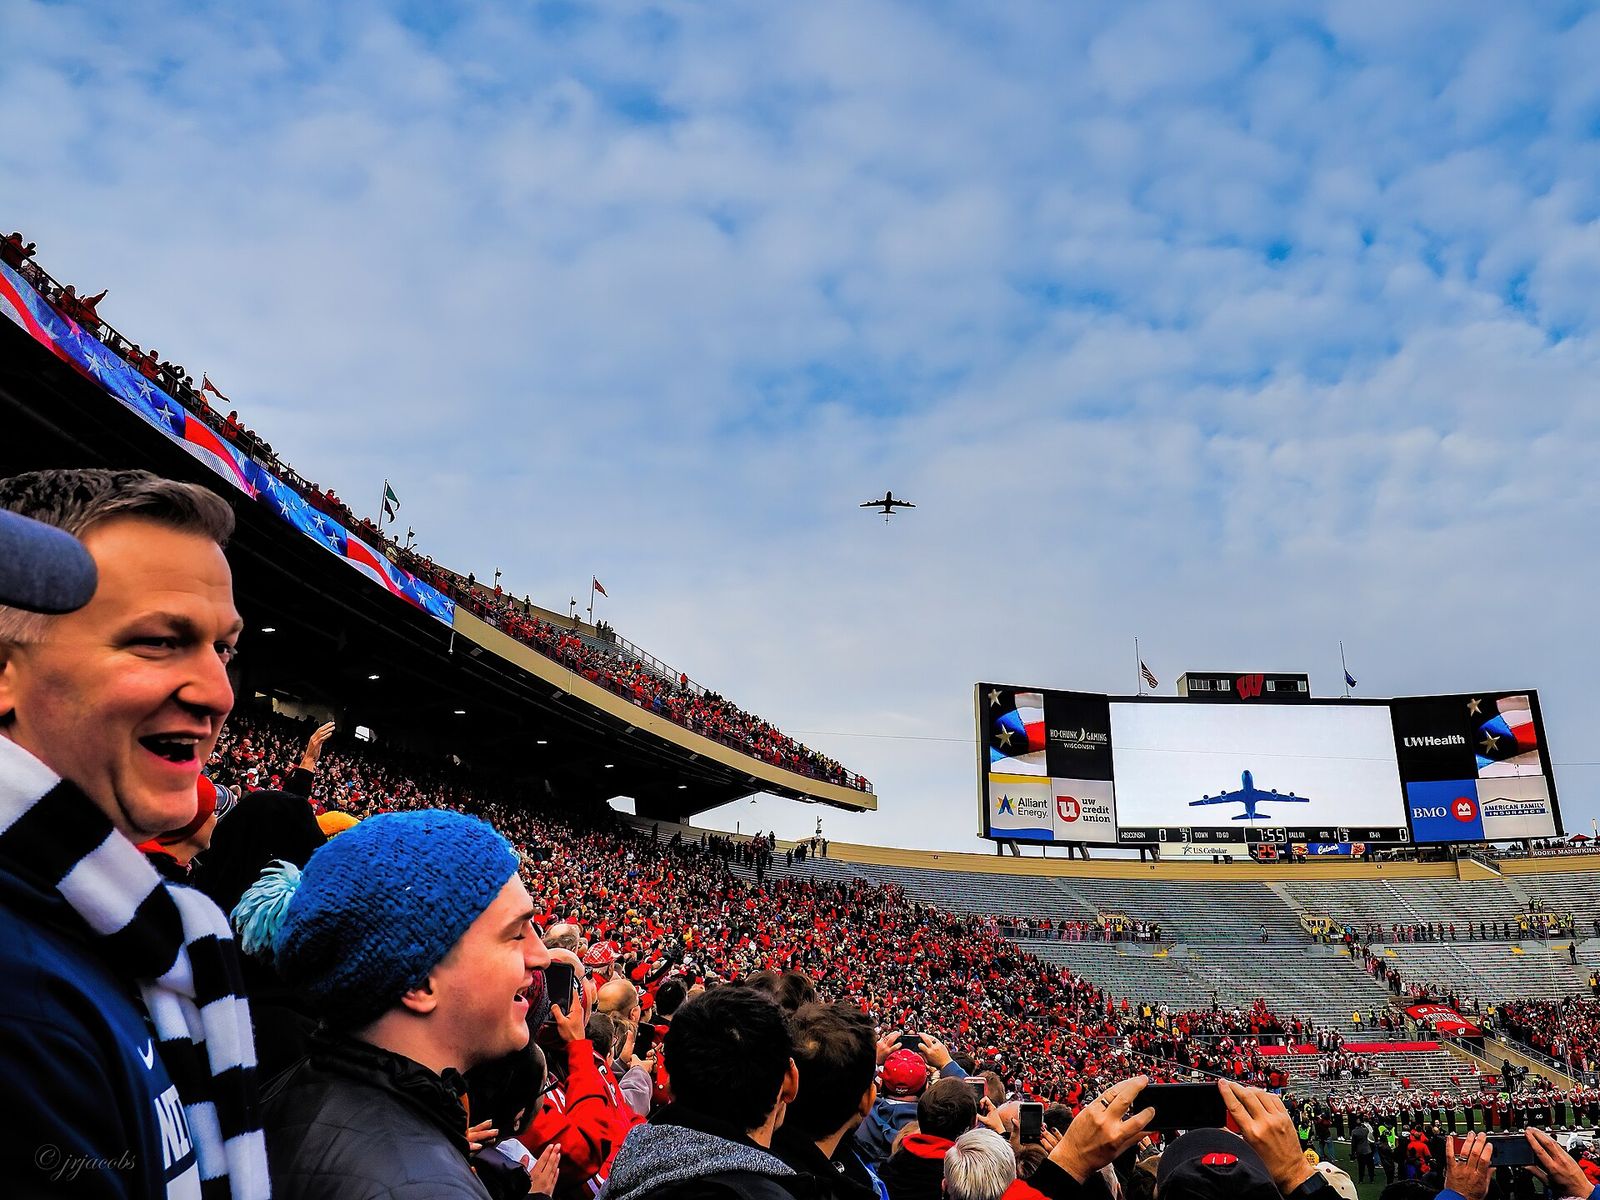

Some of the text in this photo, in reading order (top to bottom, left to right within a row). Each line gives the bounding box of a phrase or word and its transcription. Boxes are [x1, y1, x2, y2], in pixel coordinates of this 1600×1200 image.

[1236, 674, 1264, 700] W
[1086, 732, 1107, 742] GAMING
[1063, 742, 1095, 750] WISCONSIN
[1017, 797, 1048, 809] Alliant
[1081, 798, 1096, 806] uw
[1082, 805, 1110, 815] credit
[1412, 806, 1447, 819] BMO
[1082, 815, 1111, 823] union
[1121, 831, 1146, 839] WISCONSIN
[1182, 832, 1188, 843] 3
[1194, 831, 1209, 839] DOWN
[1257, 828, 1285, 842] 7:55
[1343, 832, 1350, 842] 3
[1368, 831, 1381, 839] IOWA
[1258, 845, 1277, 858] 25
